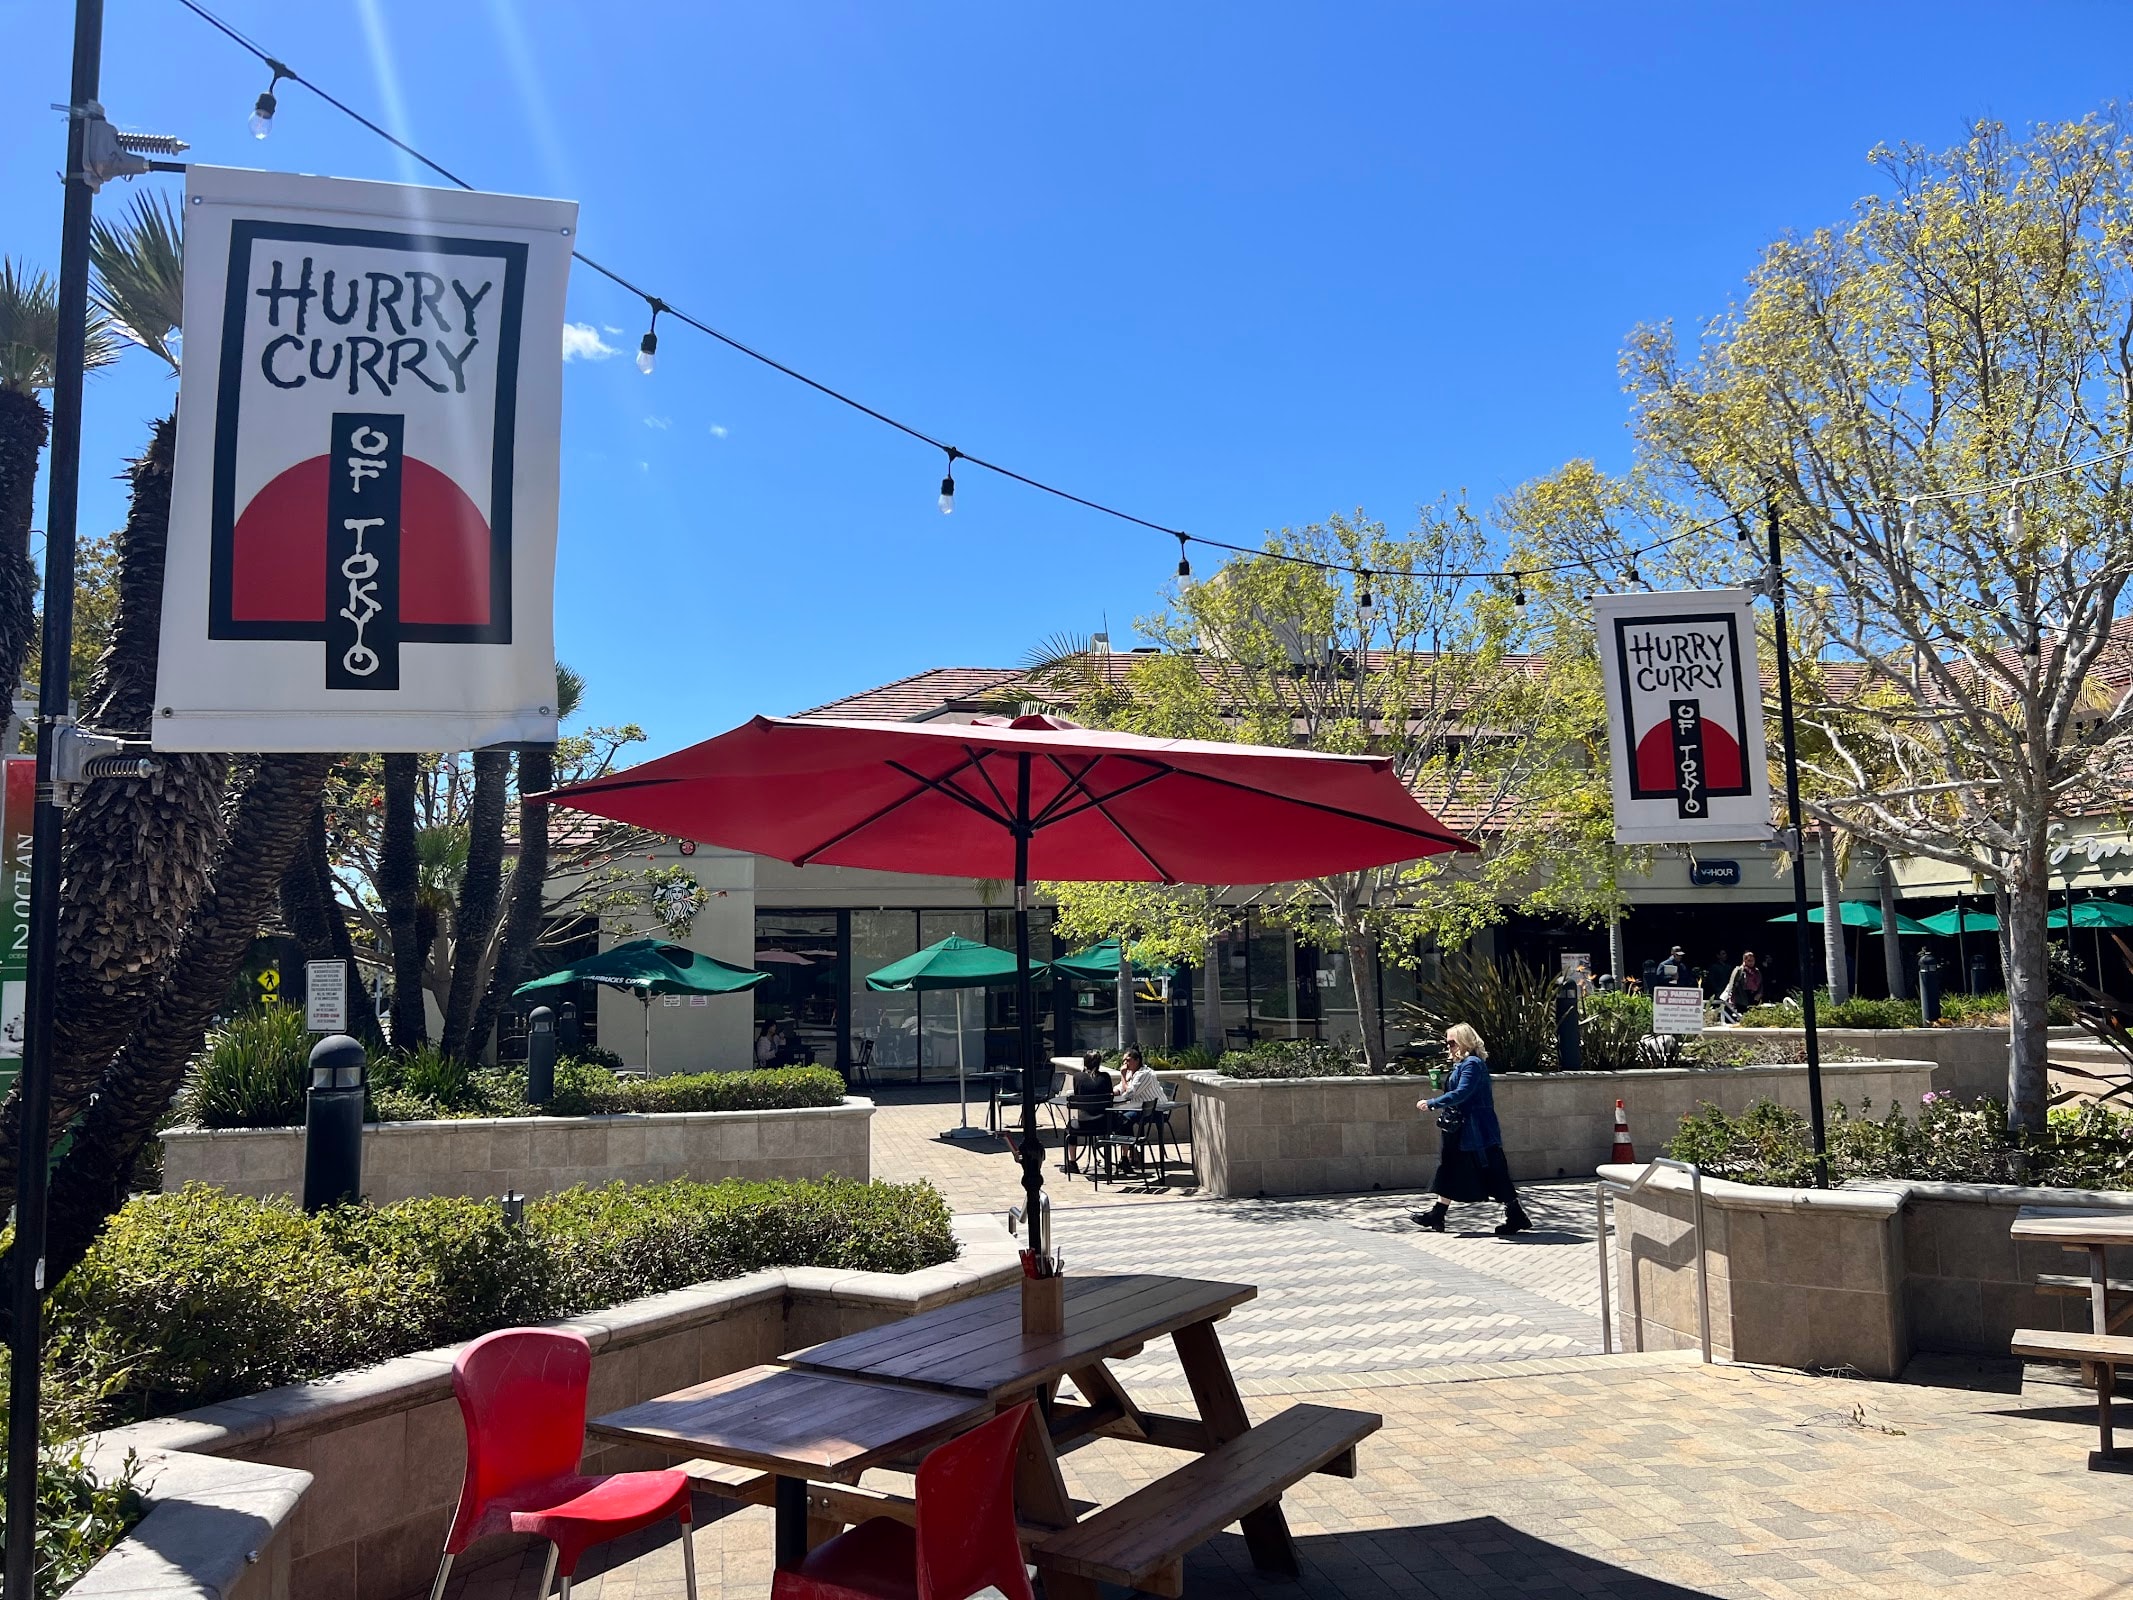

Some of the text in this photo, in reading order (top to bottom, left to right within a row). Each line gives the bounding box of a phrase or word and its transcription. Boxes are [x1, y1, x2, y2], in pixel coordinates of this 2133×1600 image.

[256, 256, 493, 336] HURRY
[261, 333, 479, 396] CURRY
[350, 425, 389, 493] OF
[340, 517, 386, 677] TOKYO
[1629, 632, 1725, 668] HURRY
[1637, 662, 1724, 692] CURRY
[1677, 705, 1695, 736] OF
[1679, 744, 1700, 814] TOKYO
[1670, 990, 1700, 998] PARKING
